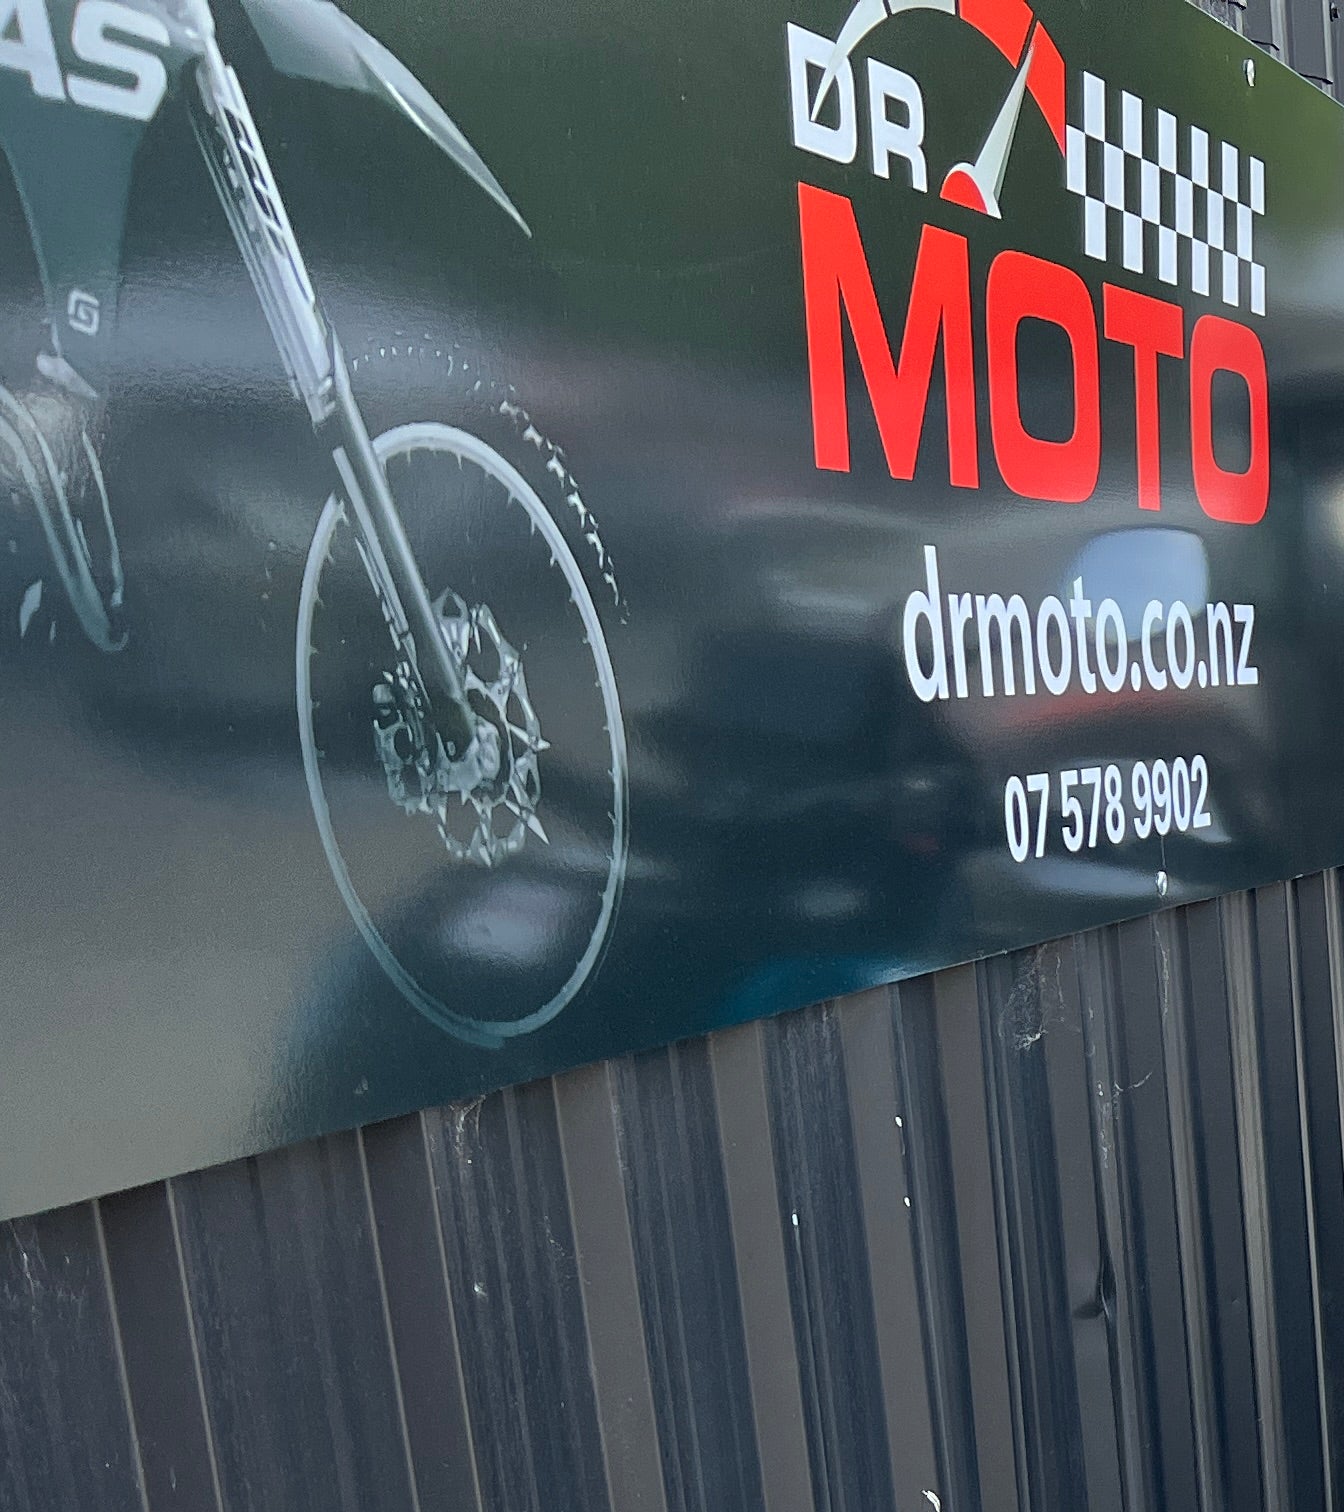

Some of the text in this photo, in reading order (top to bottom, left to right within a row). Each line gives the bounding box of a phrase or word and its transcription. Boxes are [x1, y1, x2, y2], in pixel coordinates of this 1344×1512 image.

[787, 21, 928, 193] DR
[797, 181, 1270, 525] MOTO
[902, 544, 1259, 703] drmoto.co.nz
[1005, 754, 1212, 862] 07 578 9902
